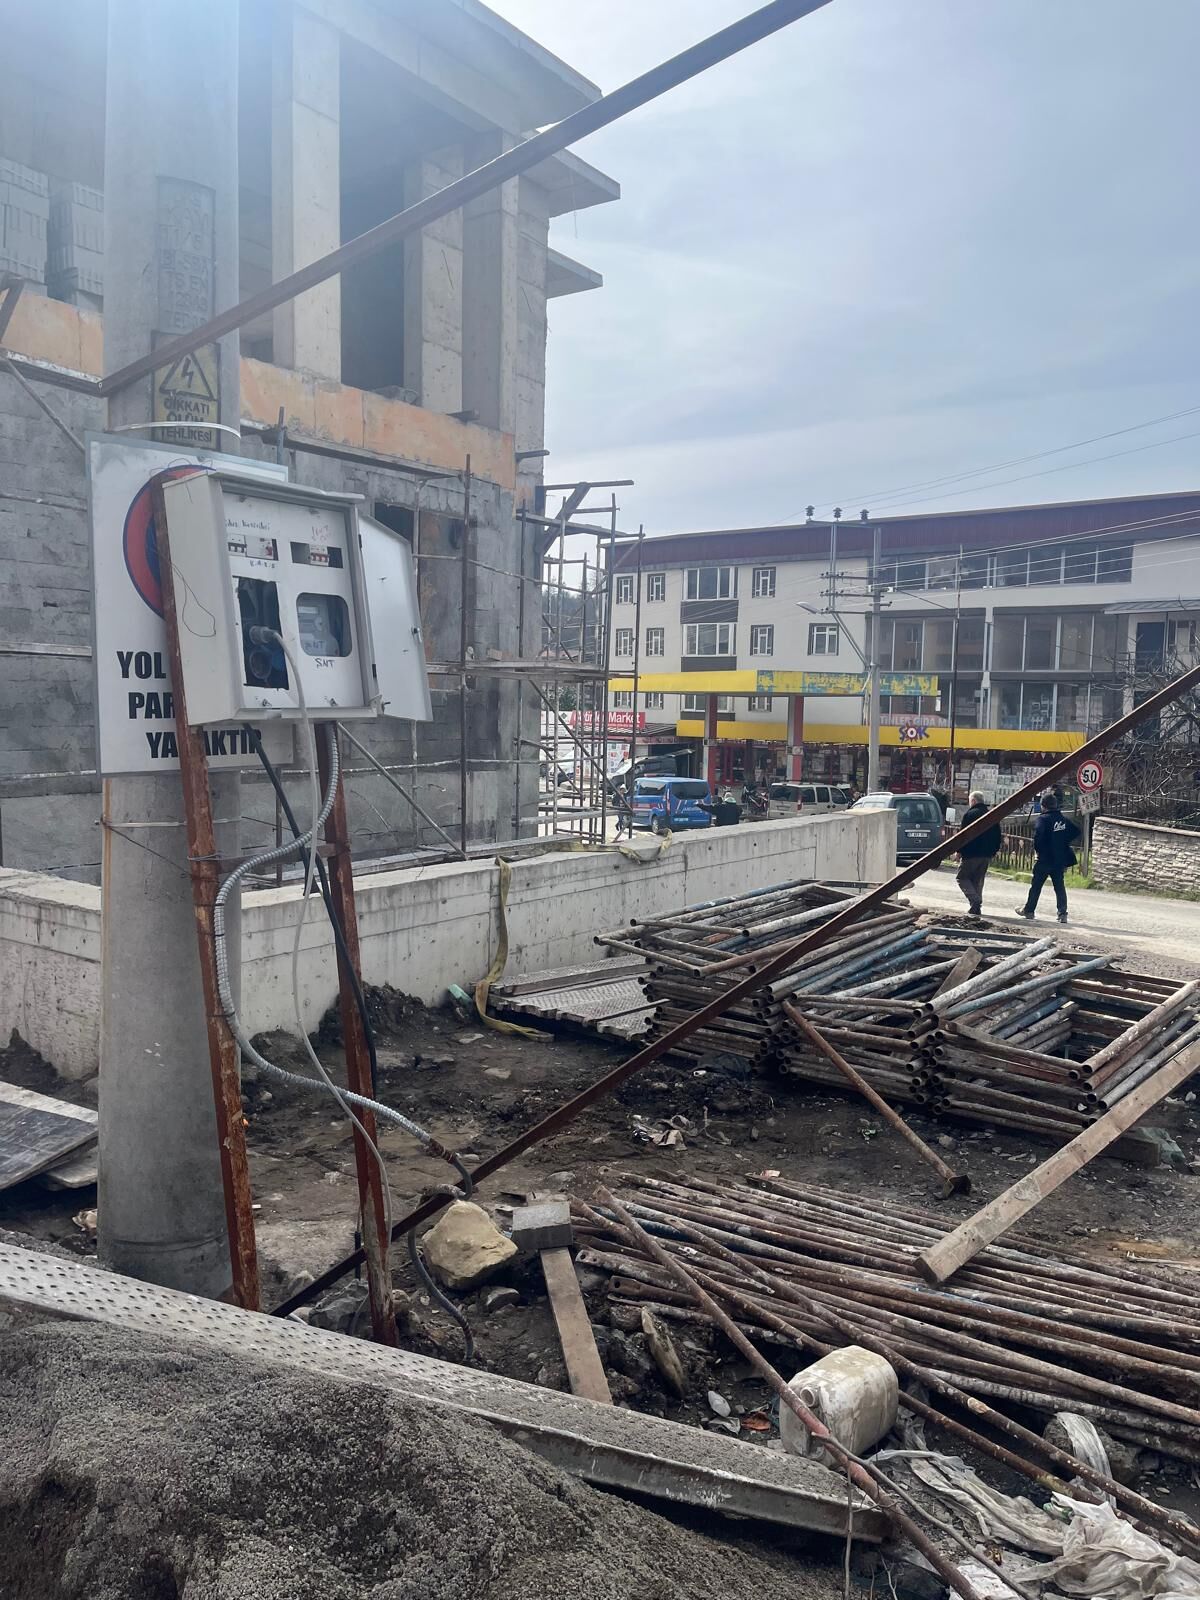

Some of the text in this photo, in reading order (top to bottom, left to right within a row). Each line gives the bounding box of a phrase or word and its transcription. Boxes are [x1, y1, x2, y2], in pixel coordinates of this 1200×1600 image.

[117, 651, 166, 679] YOL
[128, 692, 177, 719] PAR
[146, 729, 262, 759] YAAKTIR
[1082, 769, 1097, 784] 50
